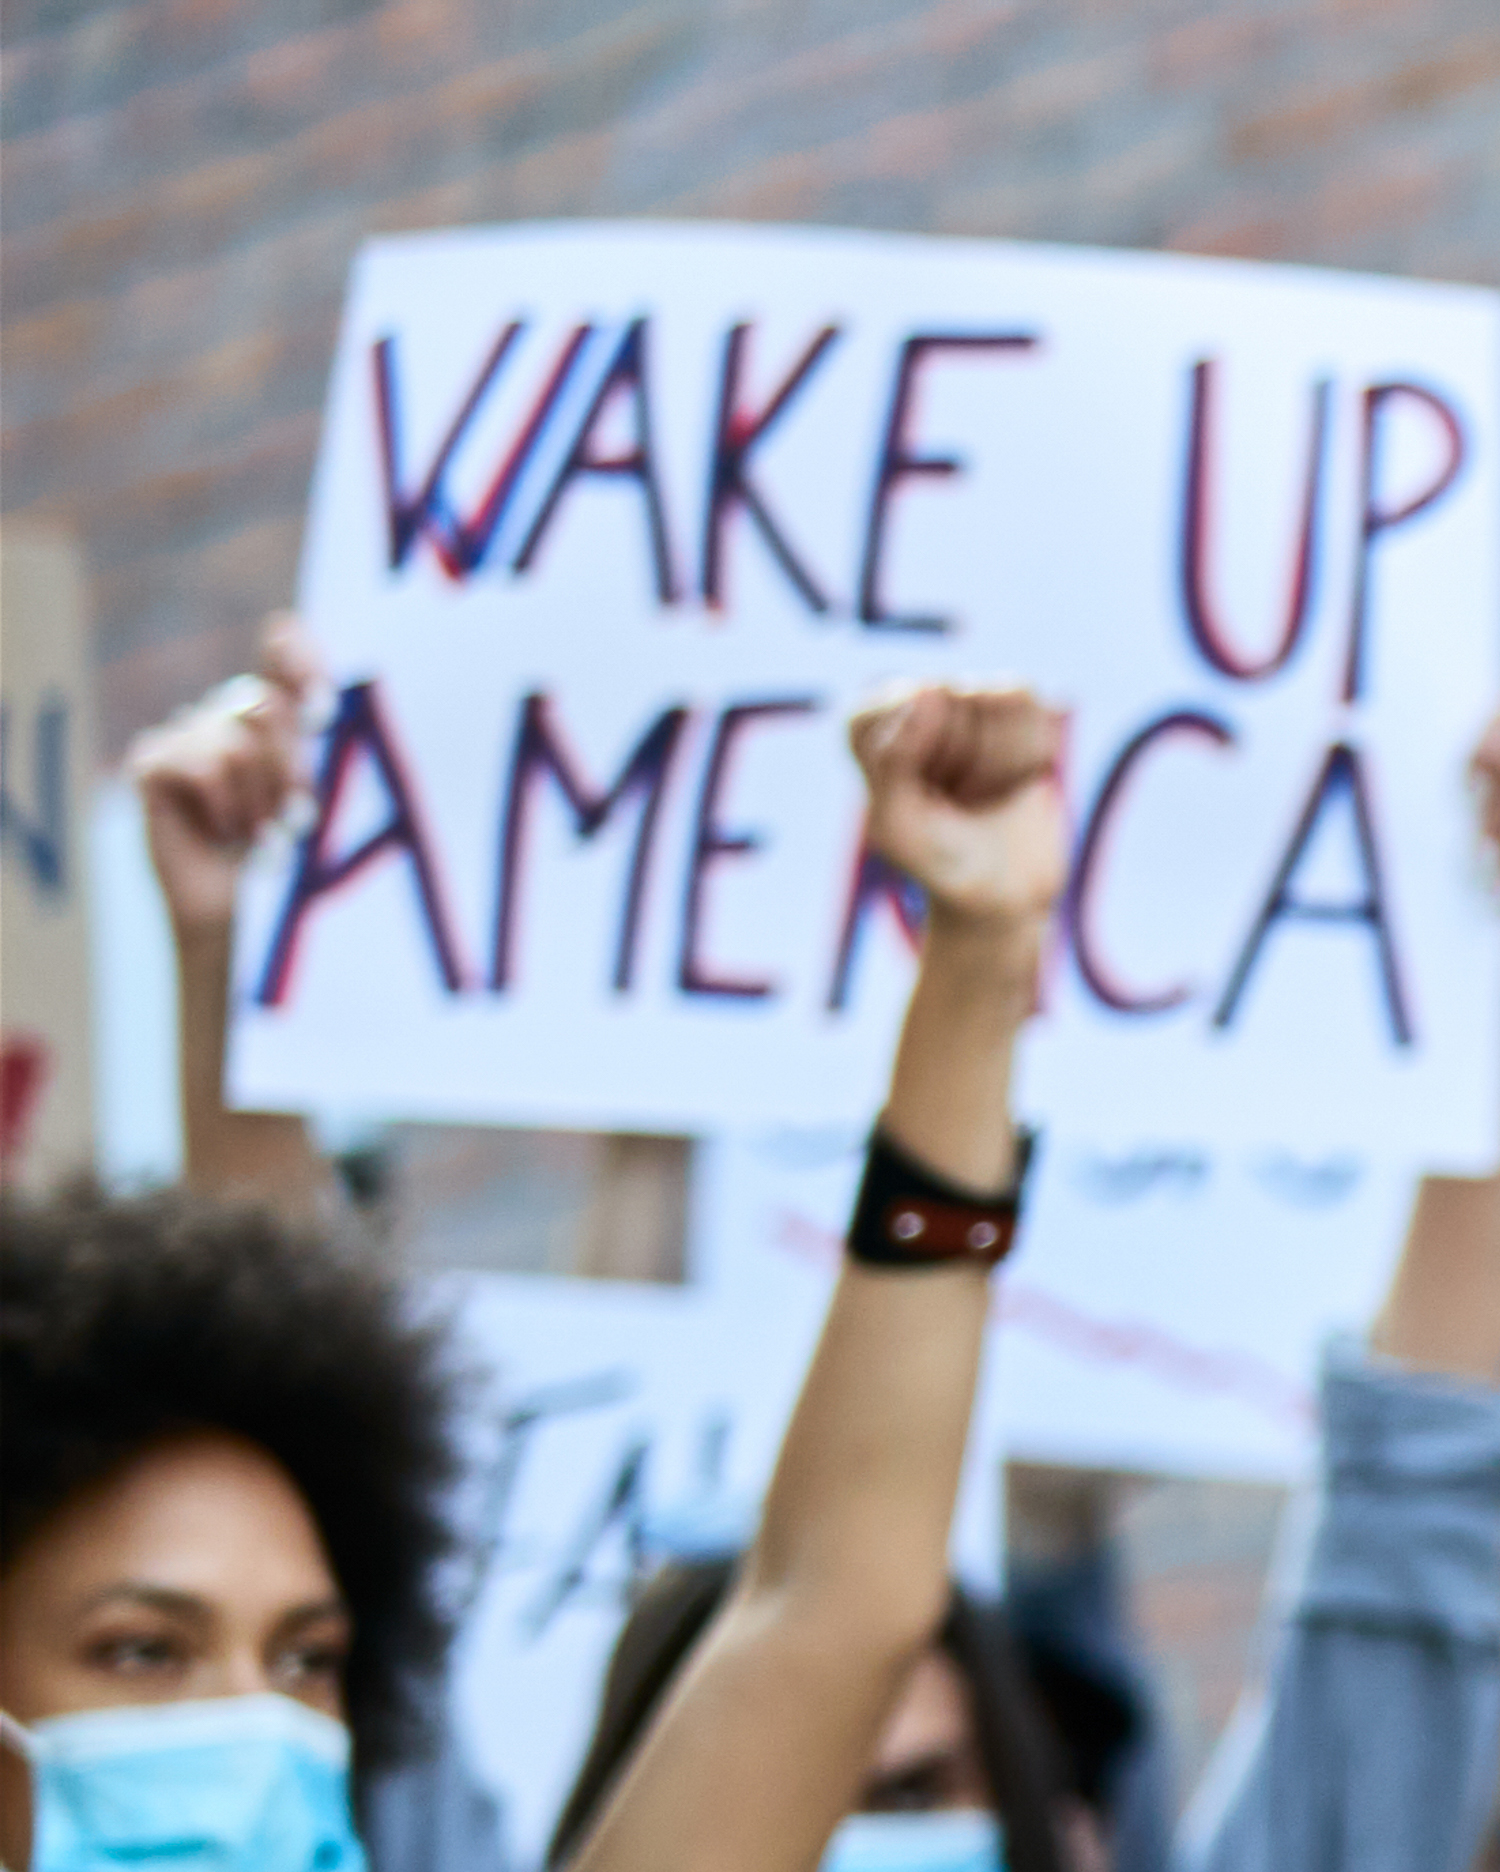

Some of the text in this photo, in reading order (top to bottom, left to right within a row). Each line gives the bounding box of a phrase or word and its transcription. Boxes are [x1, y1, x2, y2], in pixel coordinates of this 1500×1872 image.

[372, 312, 1471, 704] WAKE UP
[254, 676, 1414, 1050] AMECA
